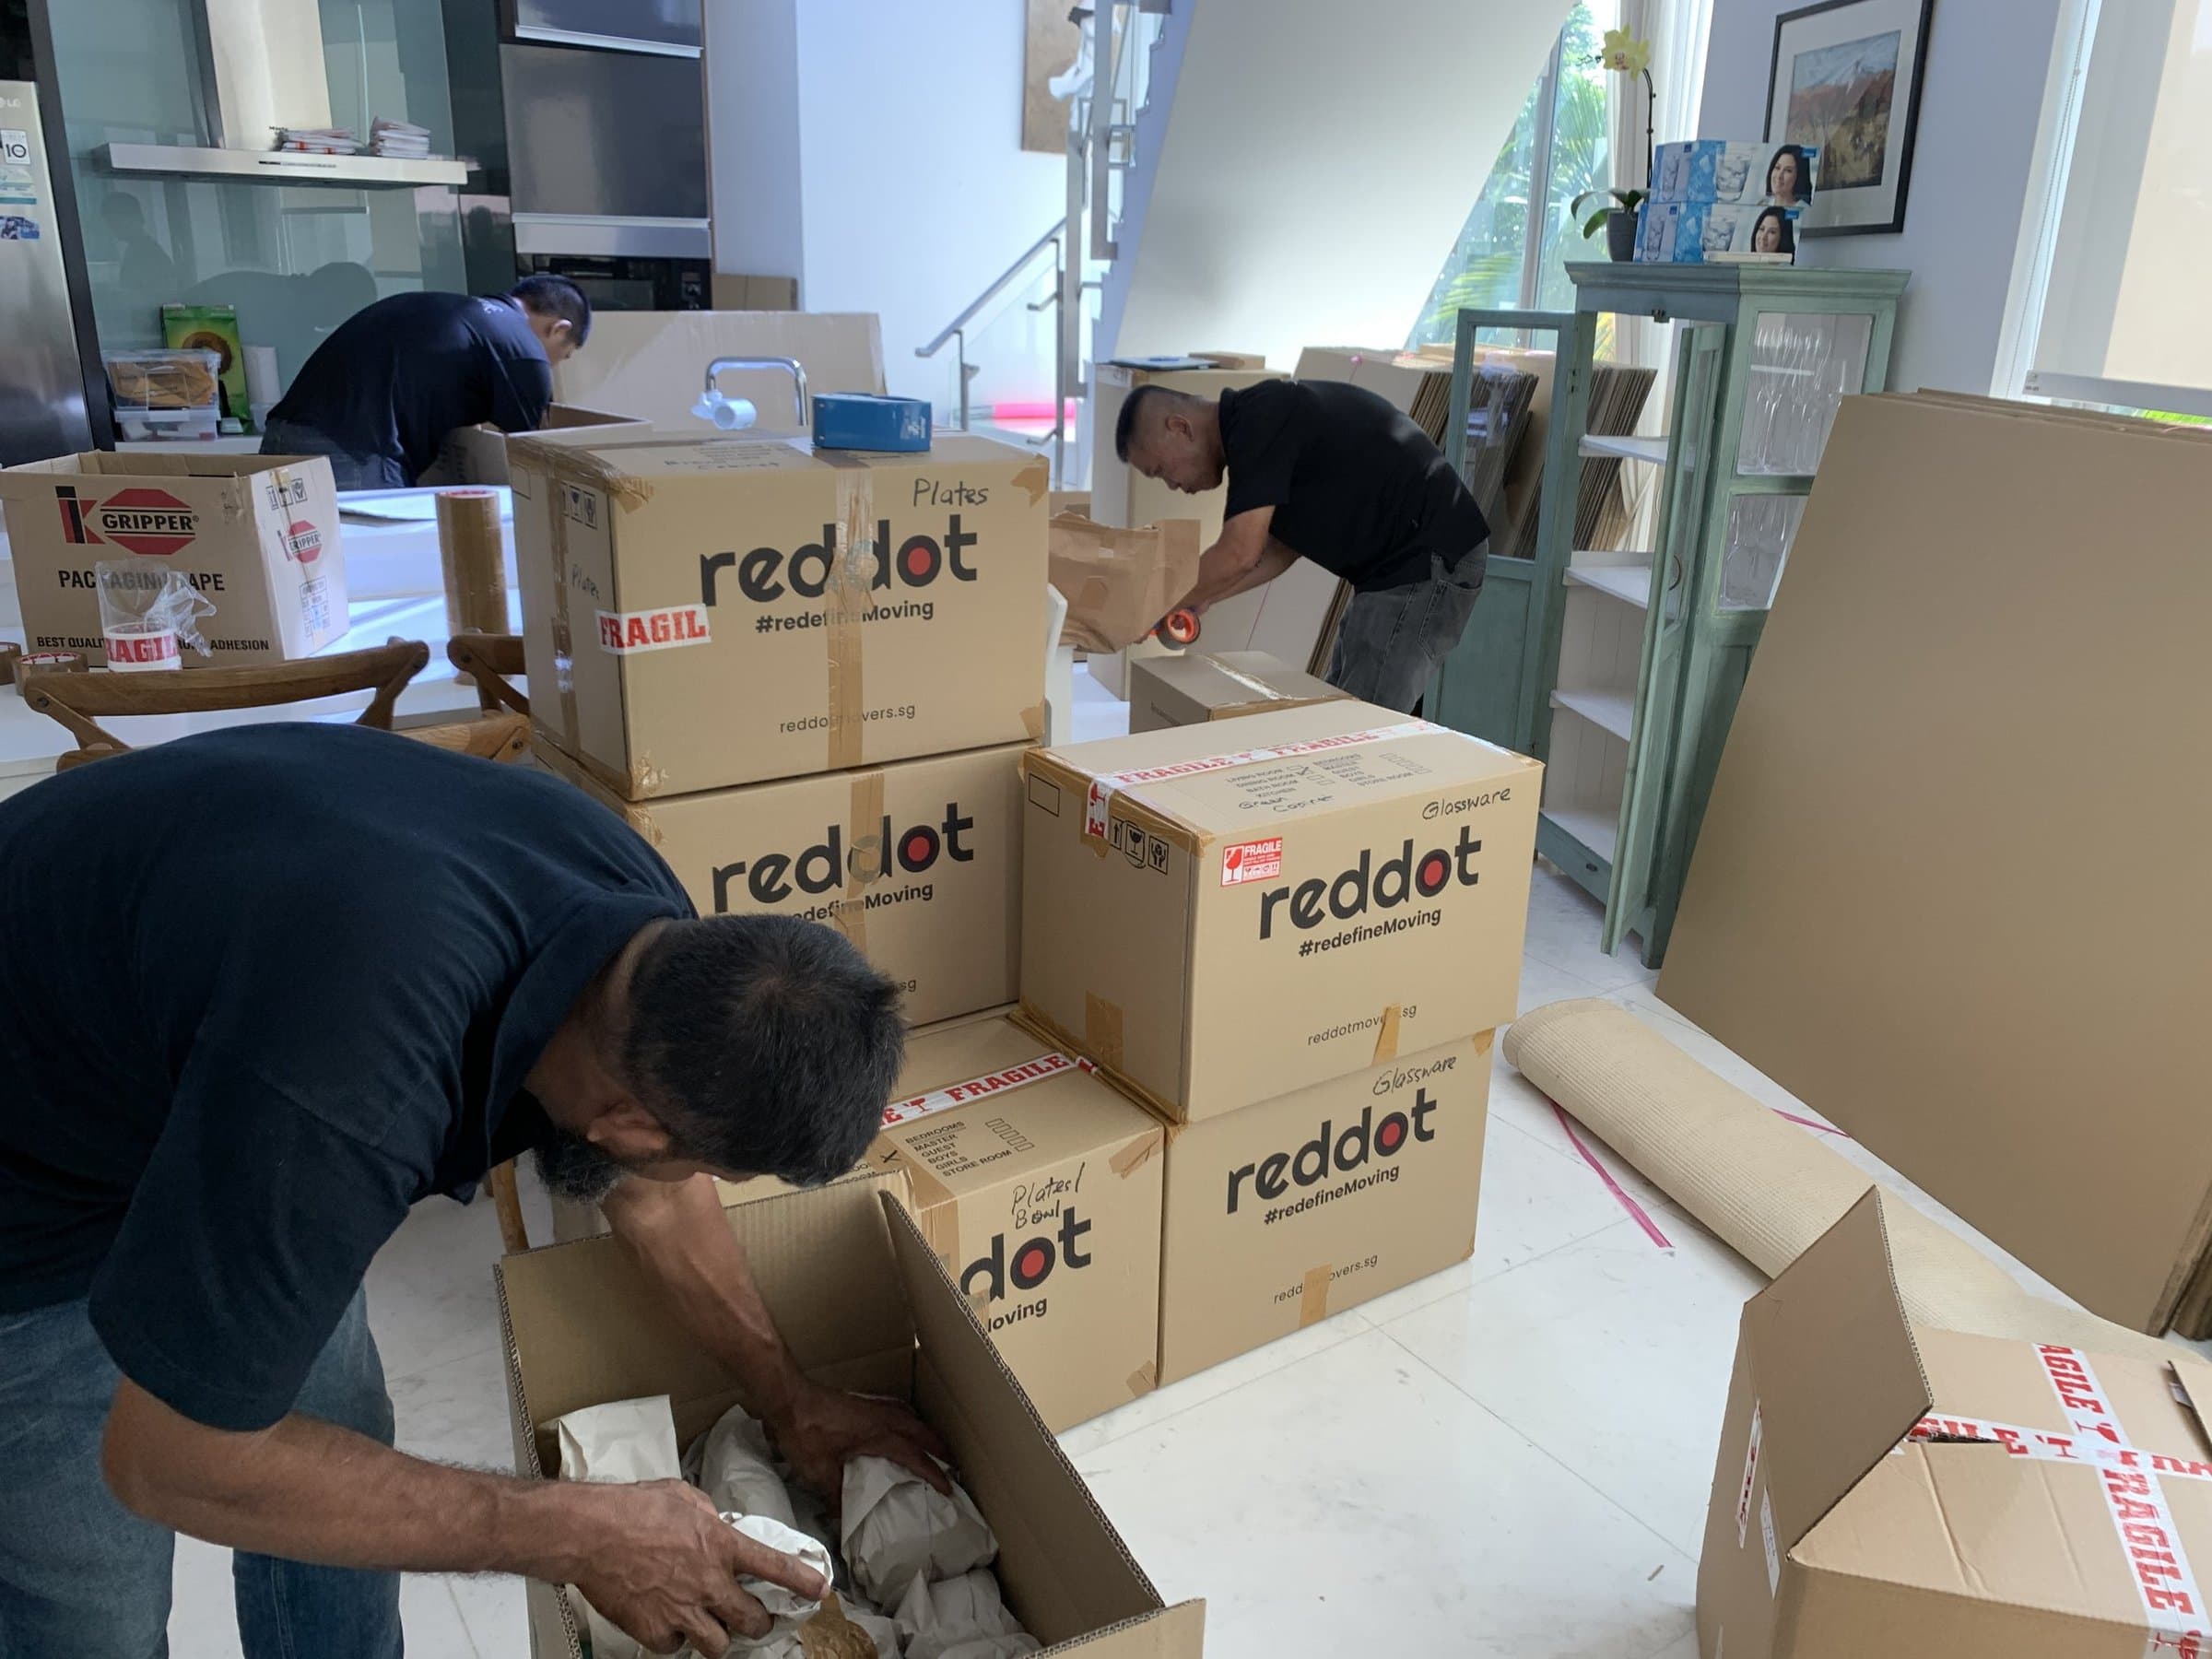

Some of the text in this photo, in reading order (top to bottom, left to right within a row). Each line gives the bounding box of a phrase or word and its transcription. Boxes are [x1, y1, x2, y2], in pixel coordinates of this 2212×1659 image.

[912, 477, 989, 506] Plates
[101, 514, 194, 531] GRIPPER
[37, 636, 105, 650] BEST QUALI
[210, 640, 269, 651] ADHESION
[1113, 757, 1235, 783] FRAGILE
[1422, 788, 1511, 820] Glassware
[712, 802, 974, 913] reddot
[1245, 840, 1282, 856] FRAGILE
[1259, 826, 1481, 940] reddot
[1299, 906, 1441, 958] #redefineMoving
[946, 1053, 1069, 1101] FRAGILE
[1371, 1056, 1457, 1097] Glassware
[905, 1121, 965, 1145] BEDROOMS
[913, 1134, 959, 1152] MASTER
[922, 1142, 957, 1159] GUEST
[927, 1150, 959, 1164] BOYS
[935, 1156, 968, 1171] GIRLS
[942, 1149, 1013, 1177] STORE ROOM
[1227, 1088, 1437, 1215] reddot
[1264, 1165, 1400, 1225] #redefineMoving
[1015, 1199, 1060, 1230] Bowl
[1274, 1254, 1379, 1304] reddovers.sg
